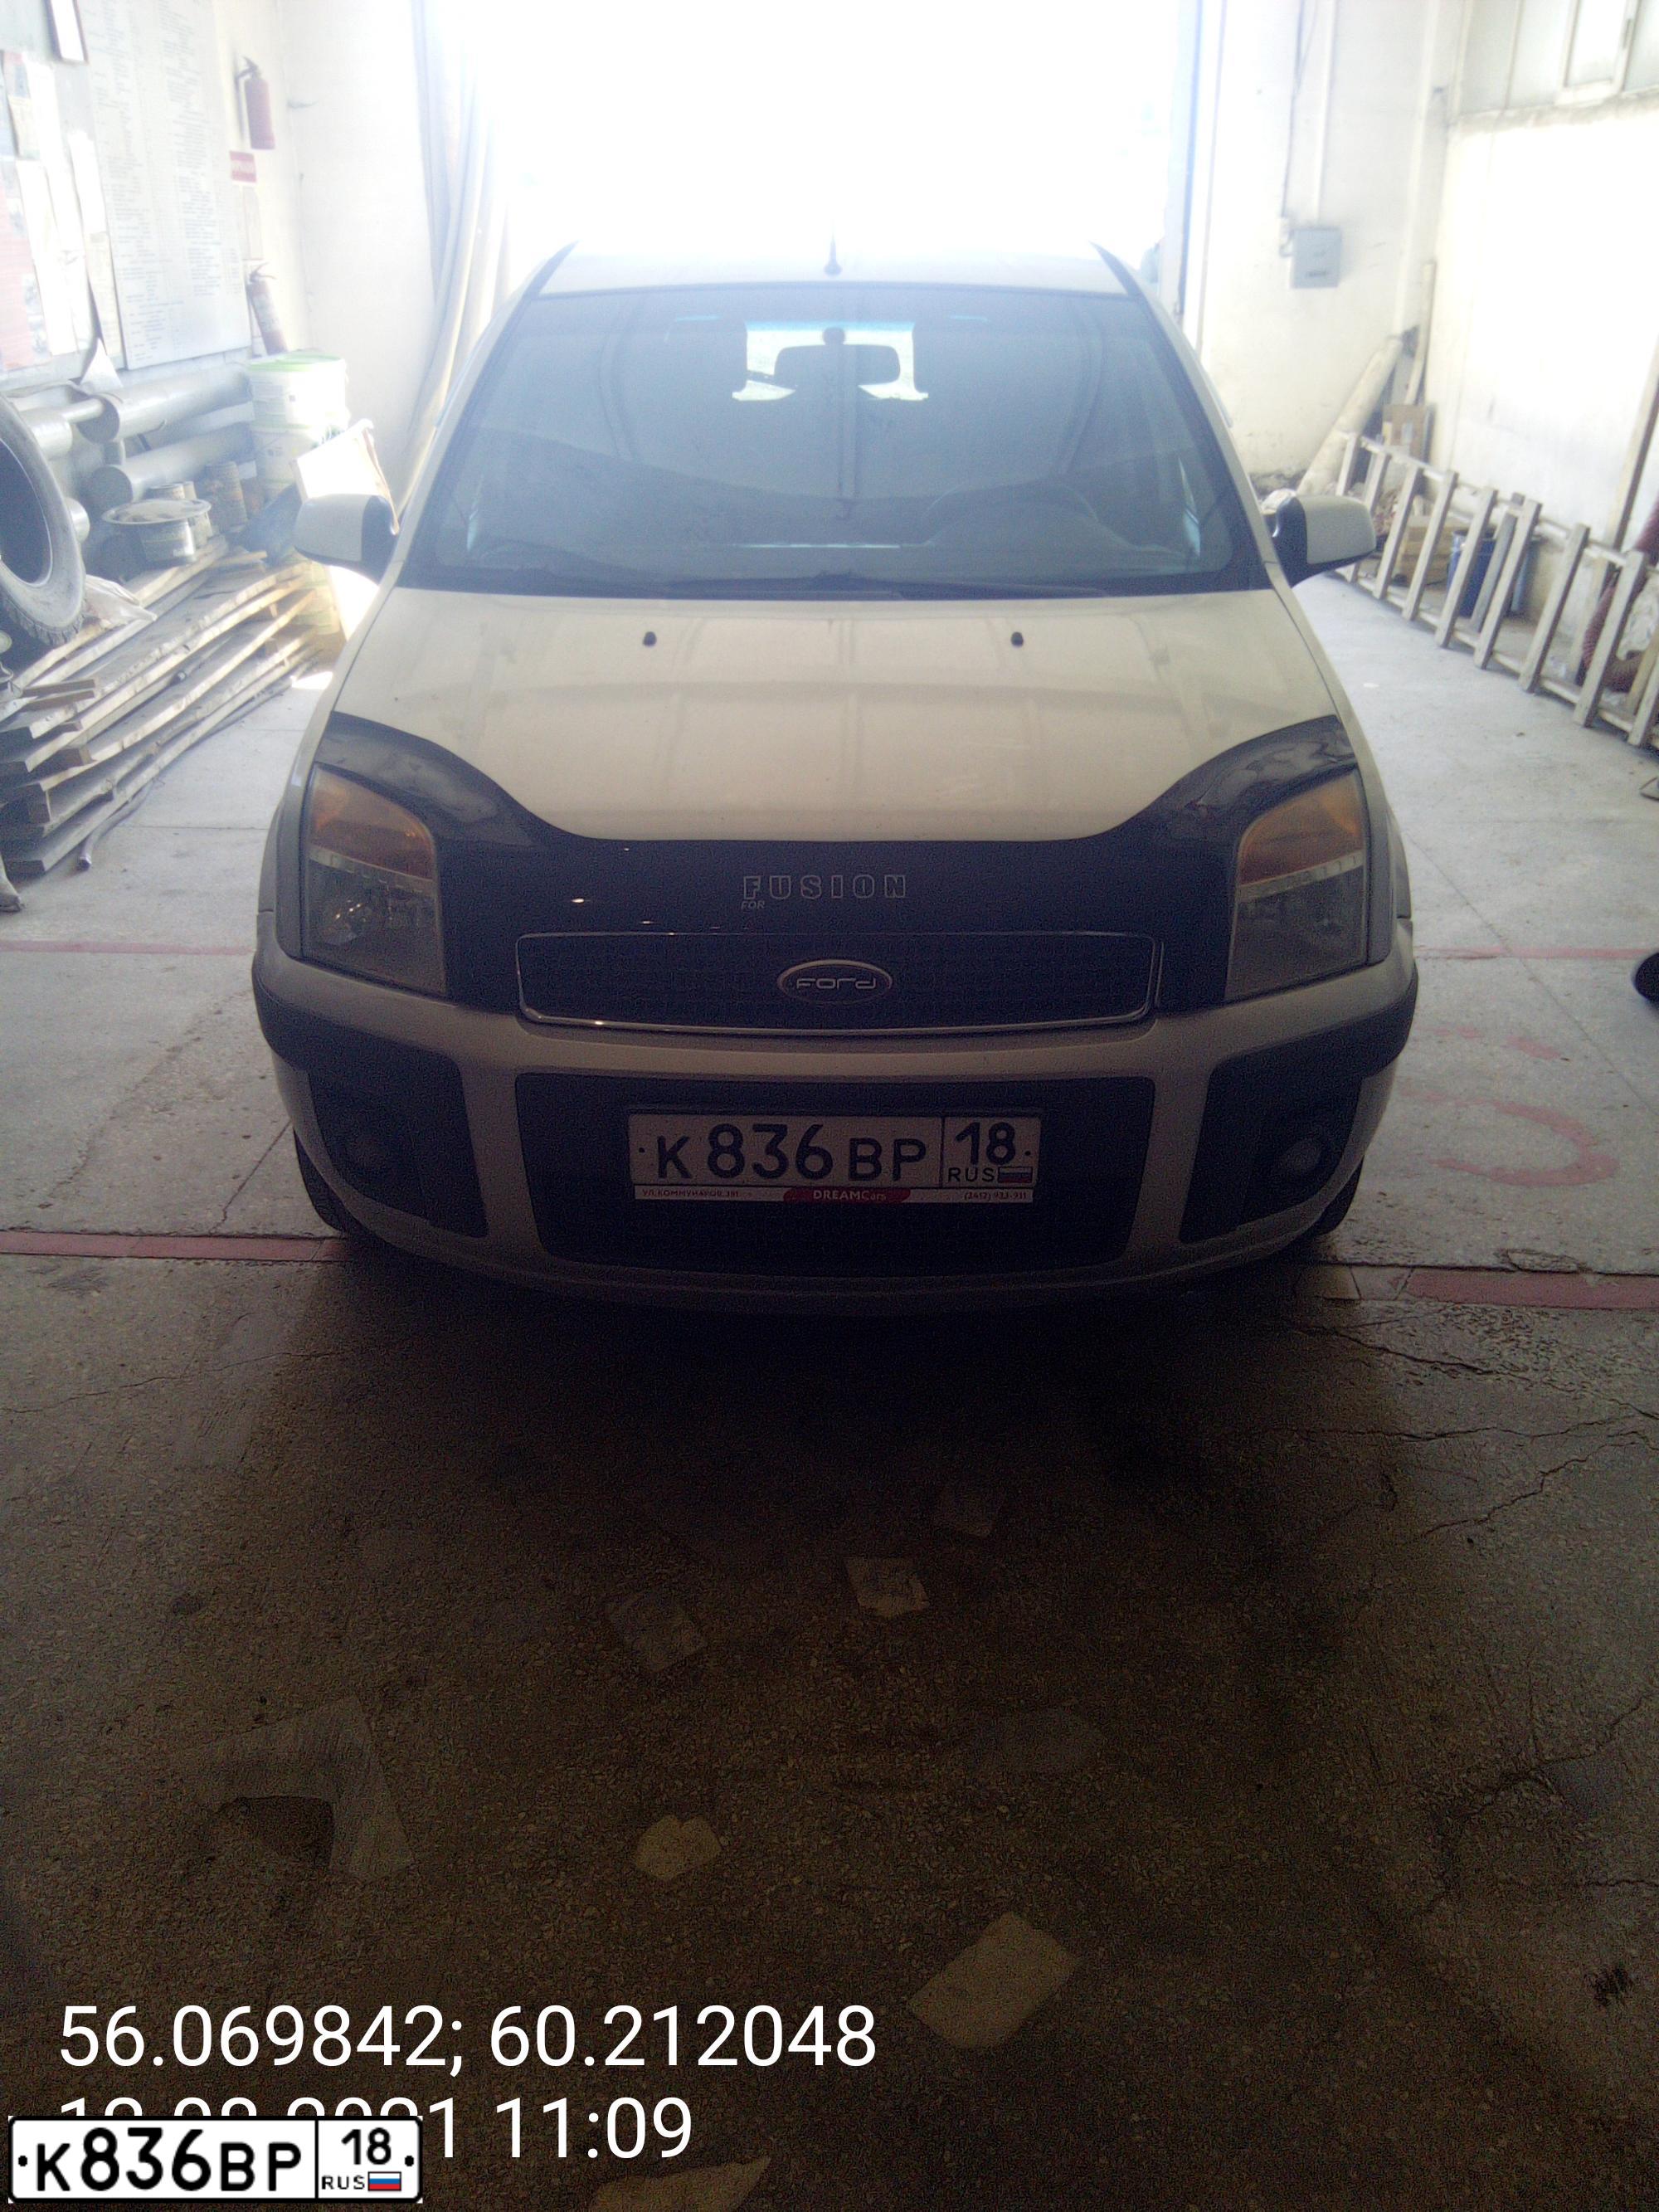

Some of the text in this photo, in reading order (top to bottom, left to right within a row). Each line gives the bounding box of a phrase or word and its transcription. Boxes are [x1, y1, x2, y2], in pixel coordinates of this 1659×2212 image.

[742, 874, 907, 900] FUSION
[955, 1121, 1017, 1166] 18
[947, 1167, 994, 1183] RUS
